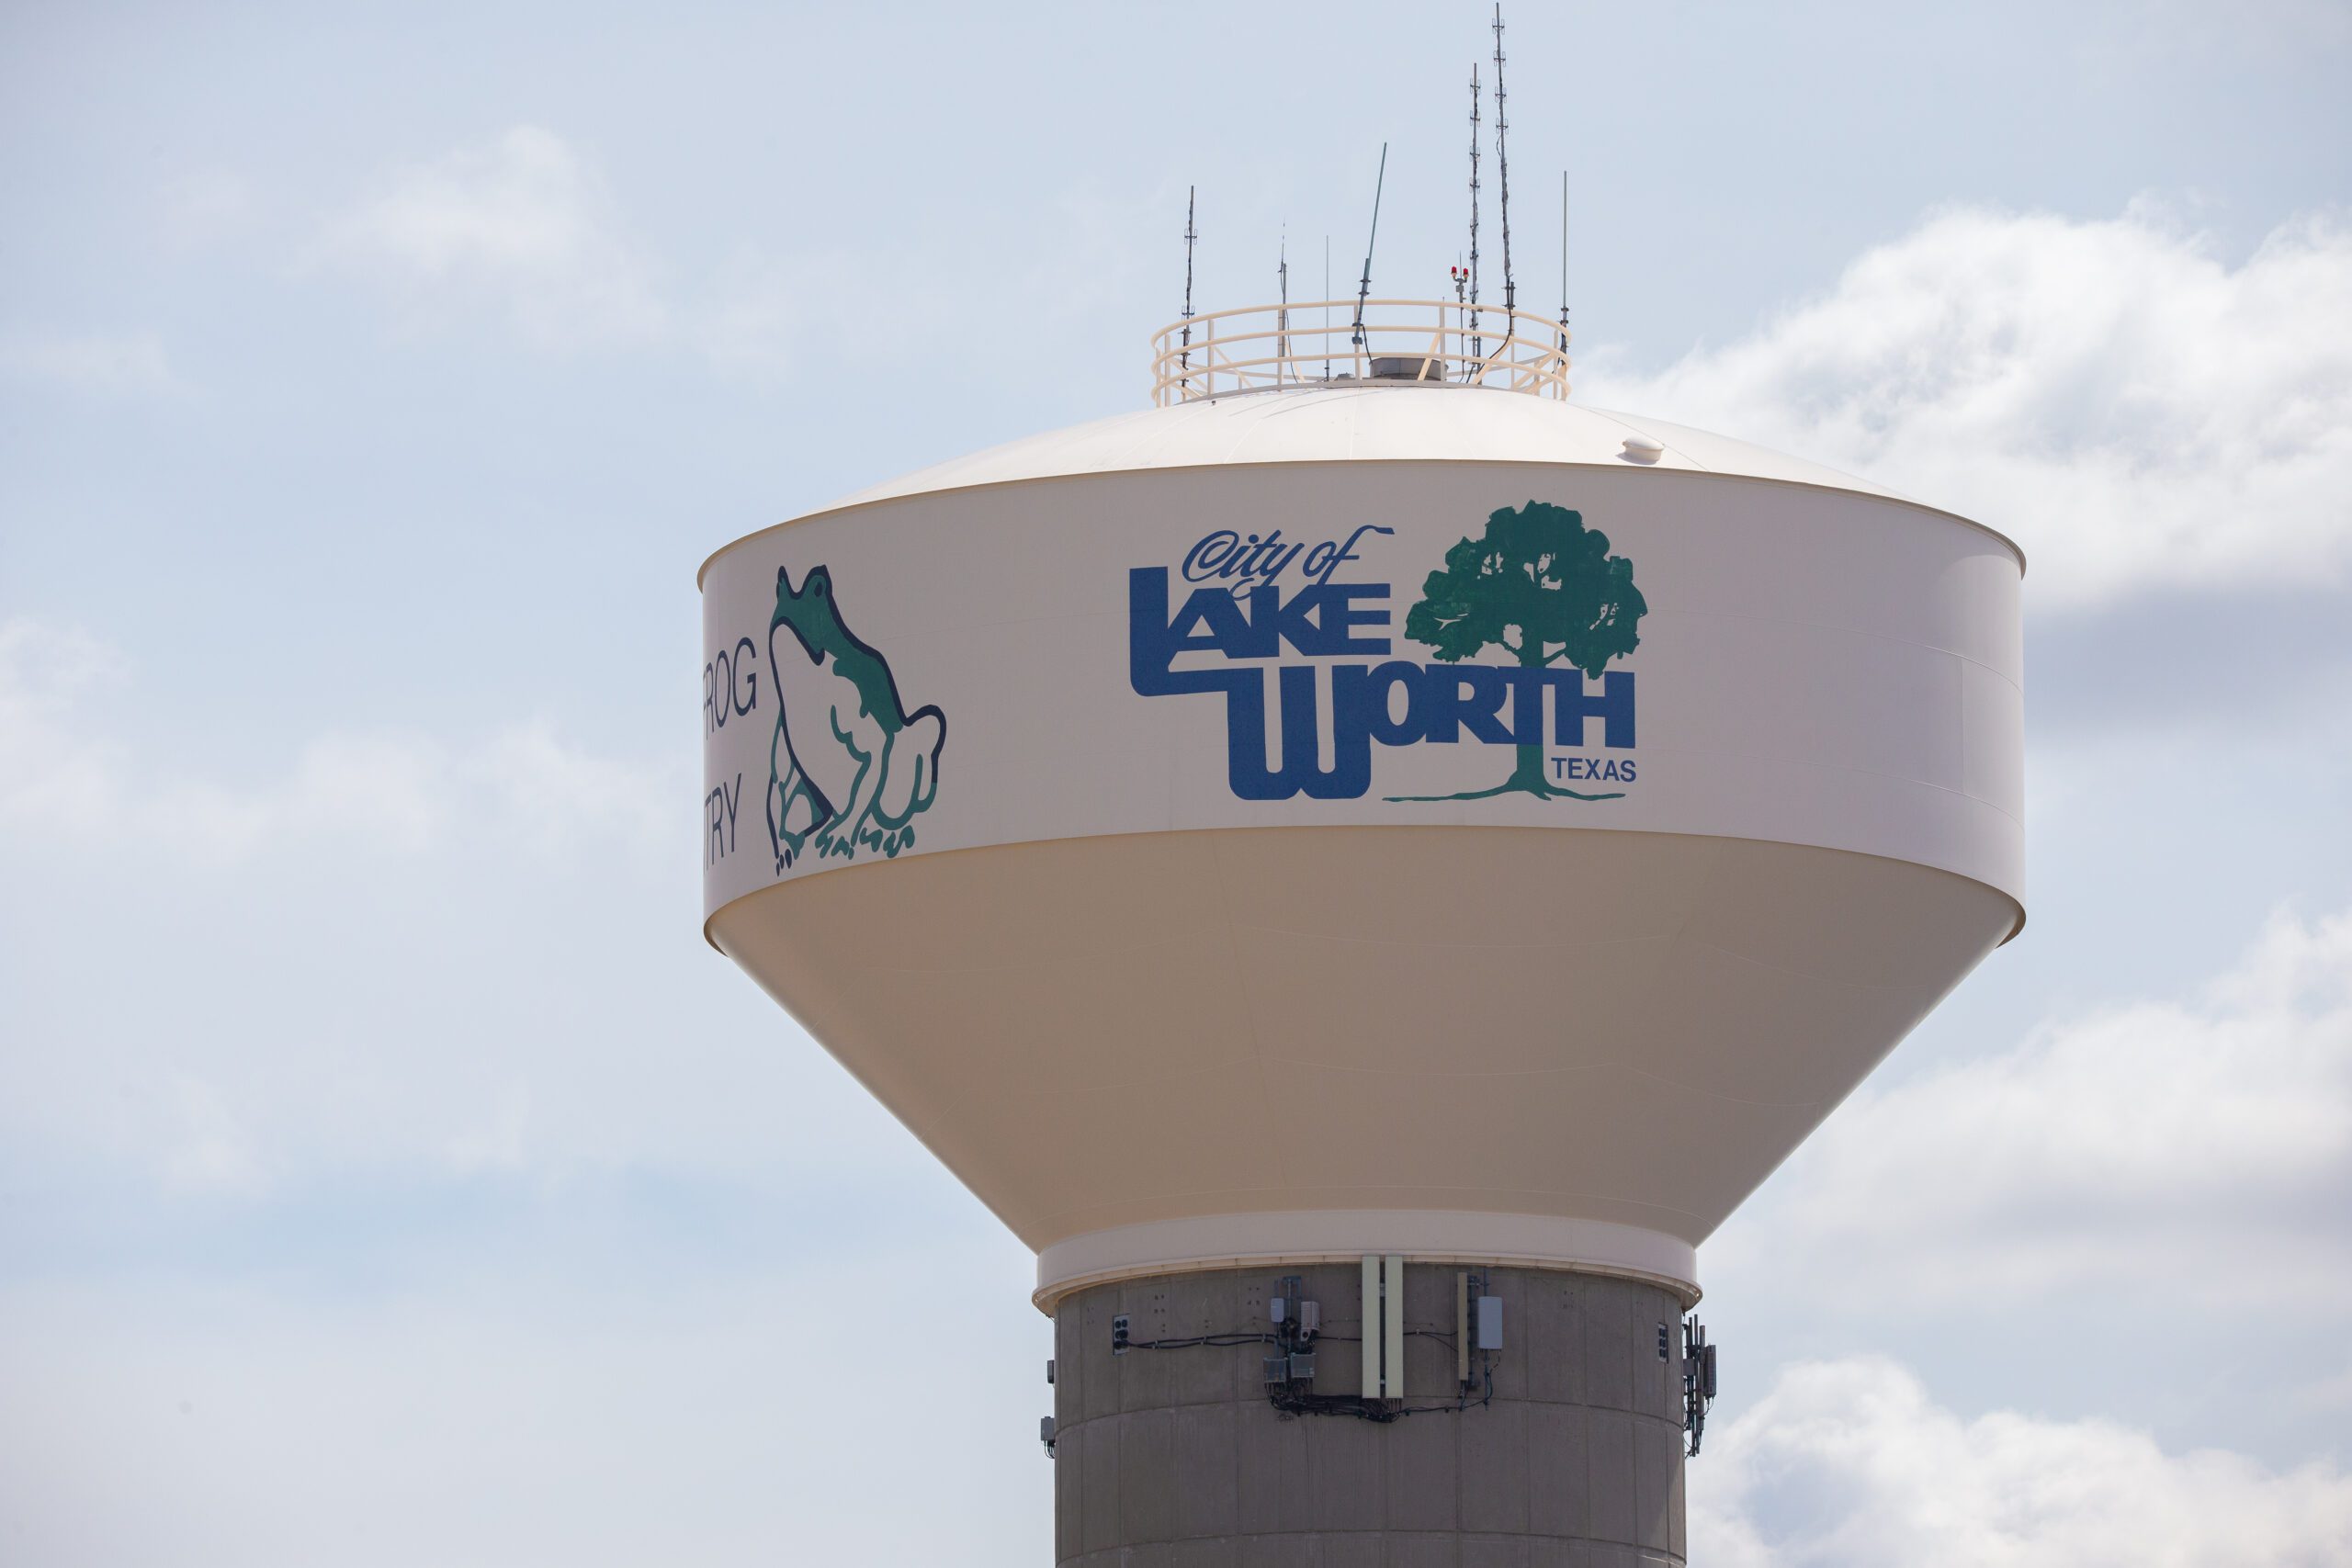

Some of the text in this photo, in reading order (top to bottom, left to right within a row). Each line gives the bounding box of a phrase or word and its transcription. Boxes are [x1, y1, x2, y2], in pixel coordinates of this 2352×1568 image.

[1182, 525, 1395, 601] City of
[1129, 566, 1391, 696] LAKE
[1227, 660, 1635, 801] WORTH
[1550, 757, 1636, 783] TEXAS
[703, 773, 742, 874] TRY
